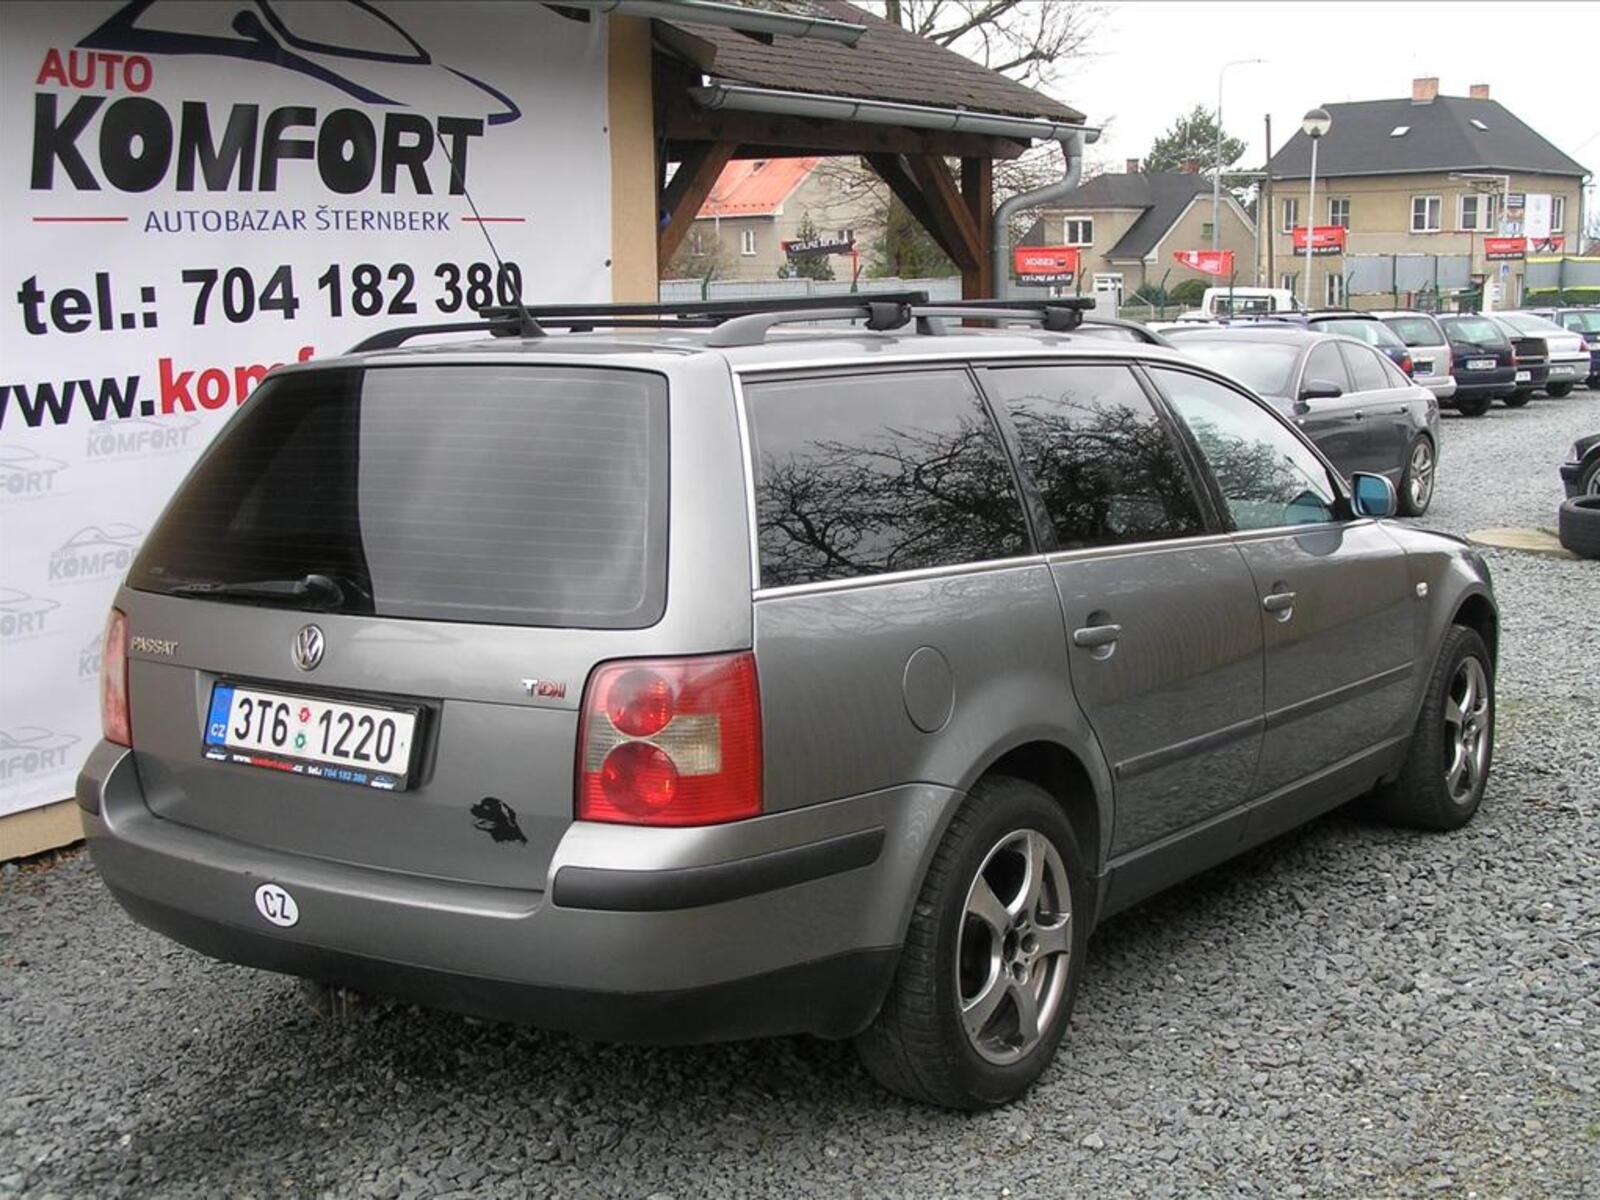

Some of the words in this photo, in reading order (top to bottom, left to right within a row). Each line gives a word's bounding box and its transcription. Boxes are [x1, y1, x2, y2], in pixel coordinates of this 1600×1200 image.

[36, 47, 154, 93] AUTO
[29, 92, 485, 196] KOMFORT
[144, 208, 307, 233] AUTOBAZAR
[315, 204, 451, 232] ŠTERNBERK
[17, 271, 159, 336] tel.:
[181, 264, 300, 326] 704
[317, 262, 418, 318] 182
[434, 261, 524, 314] 380
[86, 426, 192, 457] KOMFORT
[48, 548, 138, 581] KOMFO
[131, 635, 180, 657] PASSAT
[520, 677, 567, 699] TDI
[210, 722, 226, 738] CZ
[233, 696, 291, 747] 3T6
[318, 708, 397, 765] 1220
[262, 890, 291, 921] CZ
